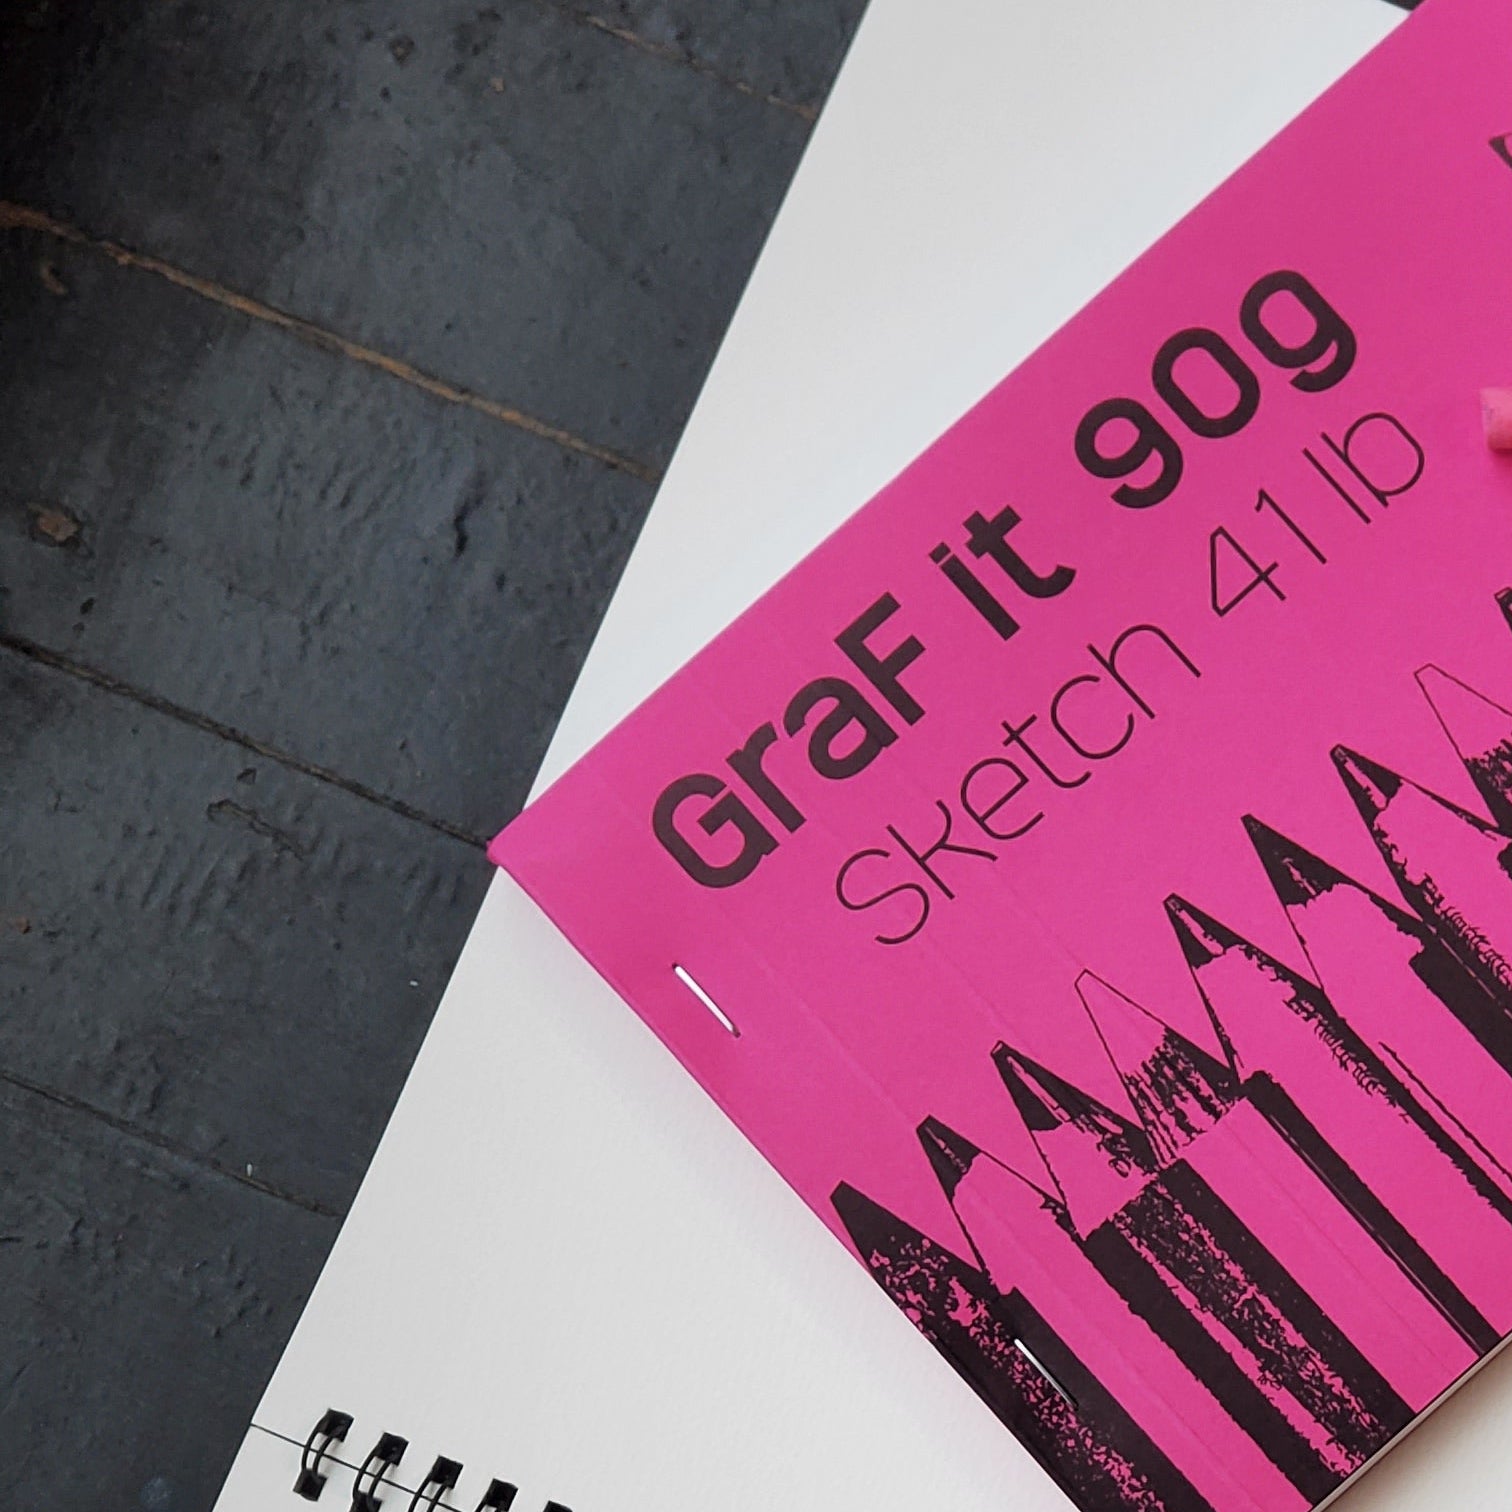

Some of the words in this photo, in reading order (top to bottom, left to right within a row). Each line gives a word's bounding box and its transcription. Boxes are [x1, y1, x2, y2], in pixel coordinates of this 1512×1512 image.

[653, 592, 926, 888] GraF
[929, 505, 1076, 641] it
[1075, 270, 1357, 508] 90g
[836, 624, 1201, 944] Sketch
[1210, 488, 1326, 616] 41
[1303, 412, 1424, 524] lb
